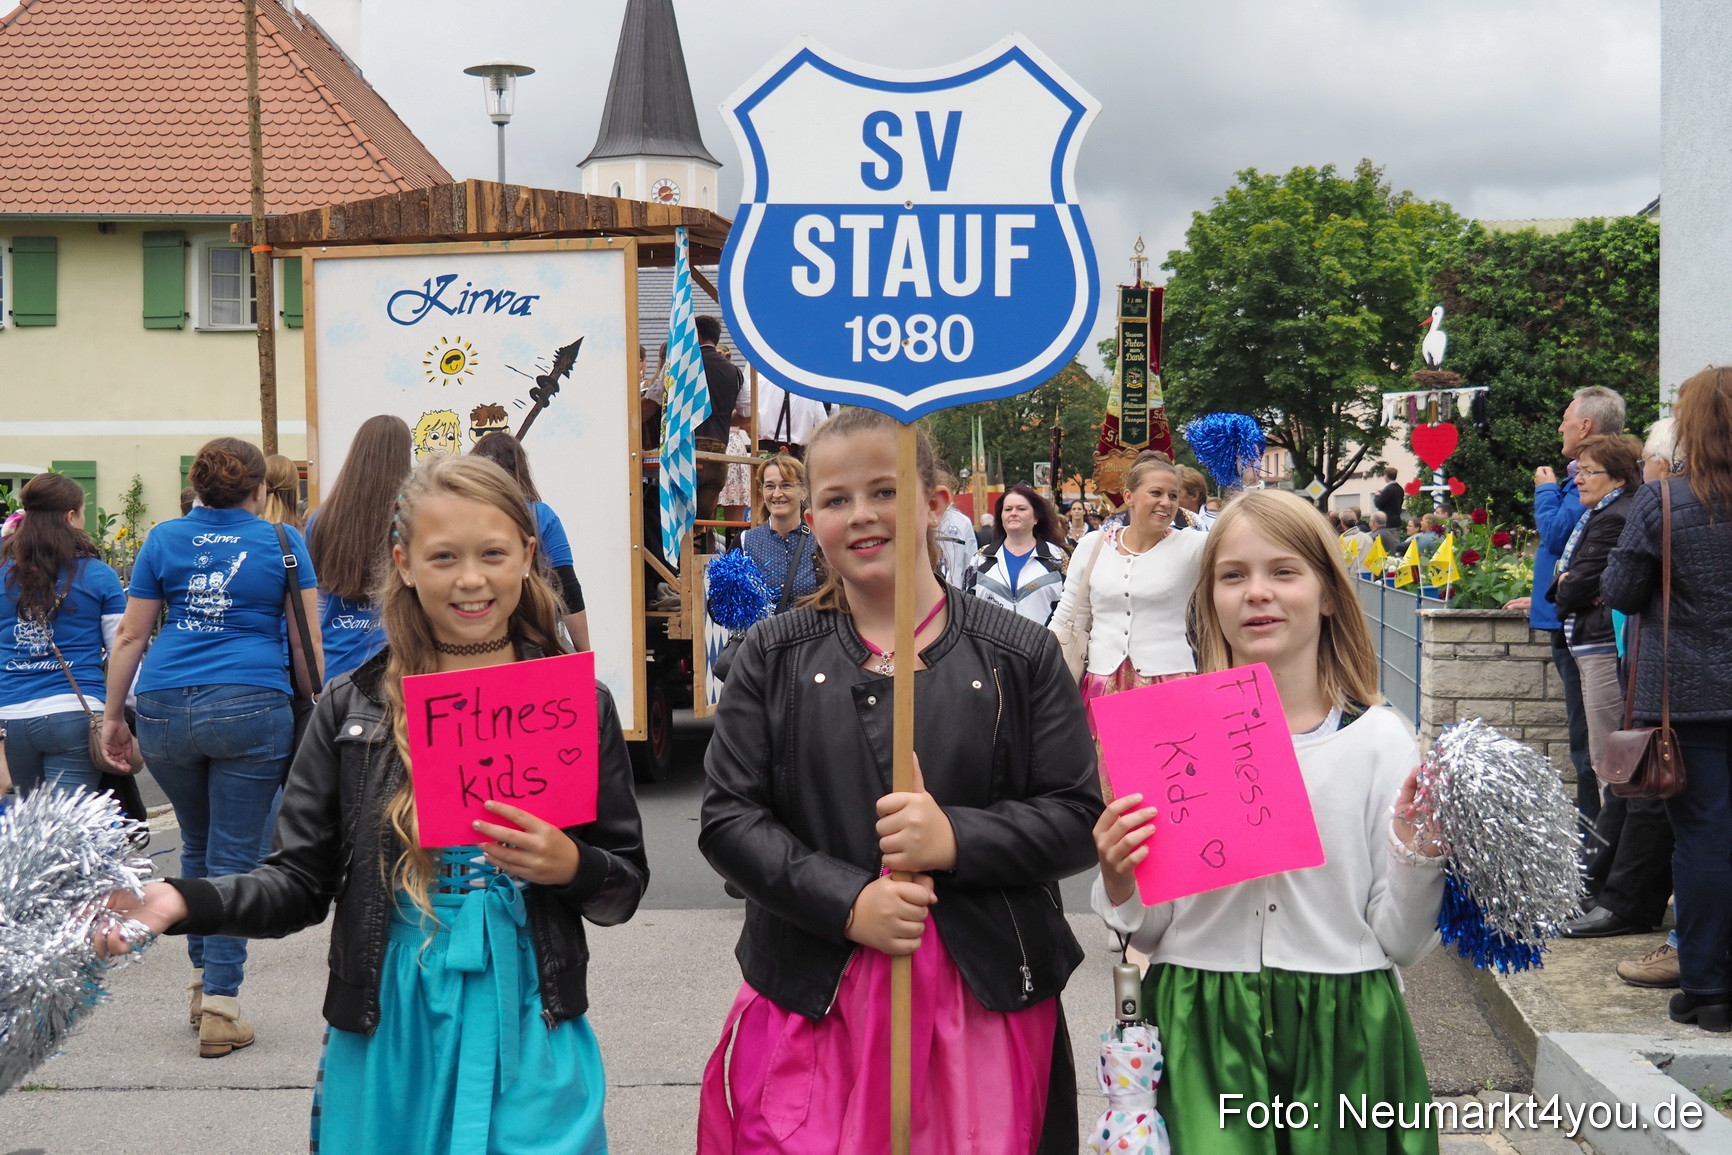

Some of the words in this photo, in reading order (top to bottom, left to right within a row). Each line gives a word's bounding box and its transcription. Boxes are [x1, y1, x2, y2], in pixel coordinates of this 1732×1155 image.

[860, 109, 963, 192] SV
[790, 213, 1036, 298] STAUF
[386, 273, 541, 326] Kirwa
[844, 313, 975, 363] 1980
[1125, 352, 1146, 362] Dank
[192, 533, 241, 547] Kirwa
[424, 686, 578, 748] Fitness
[1214, 669, 1272, 827] Fitness
